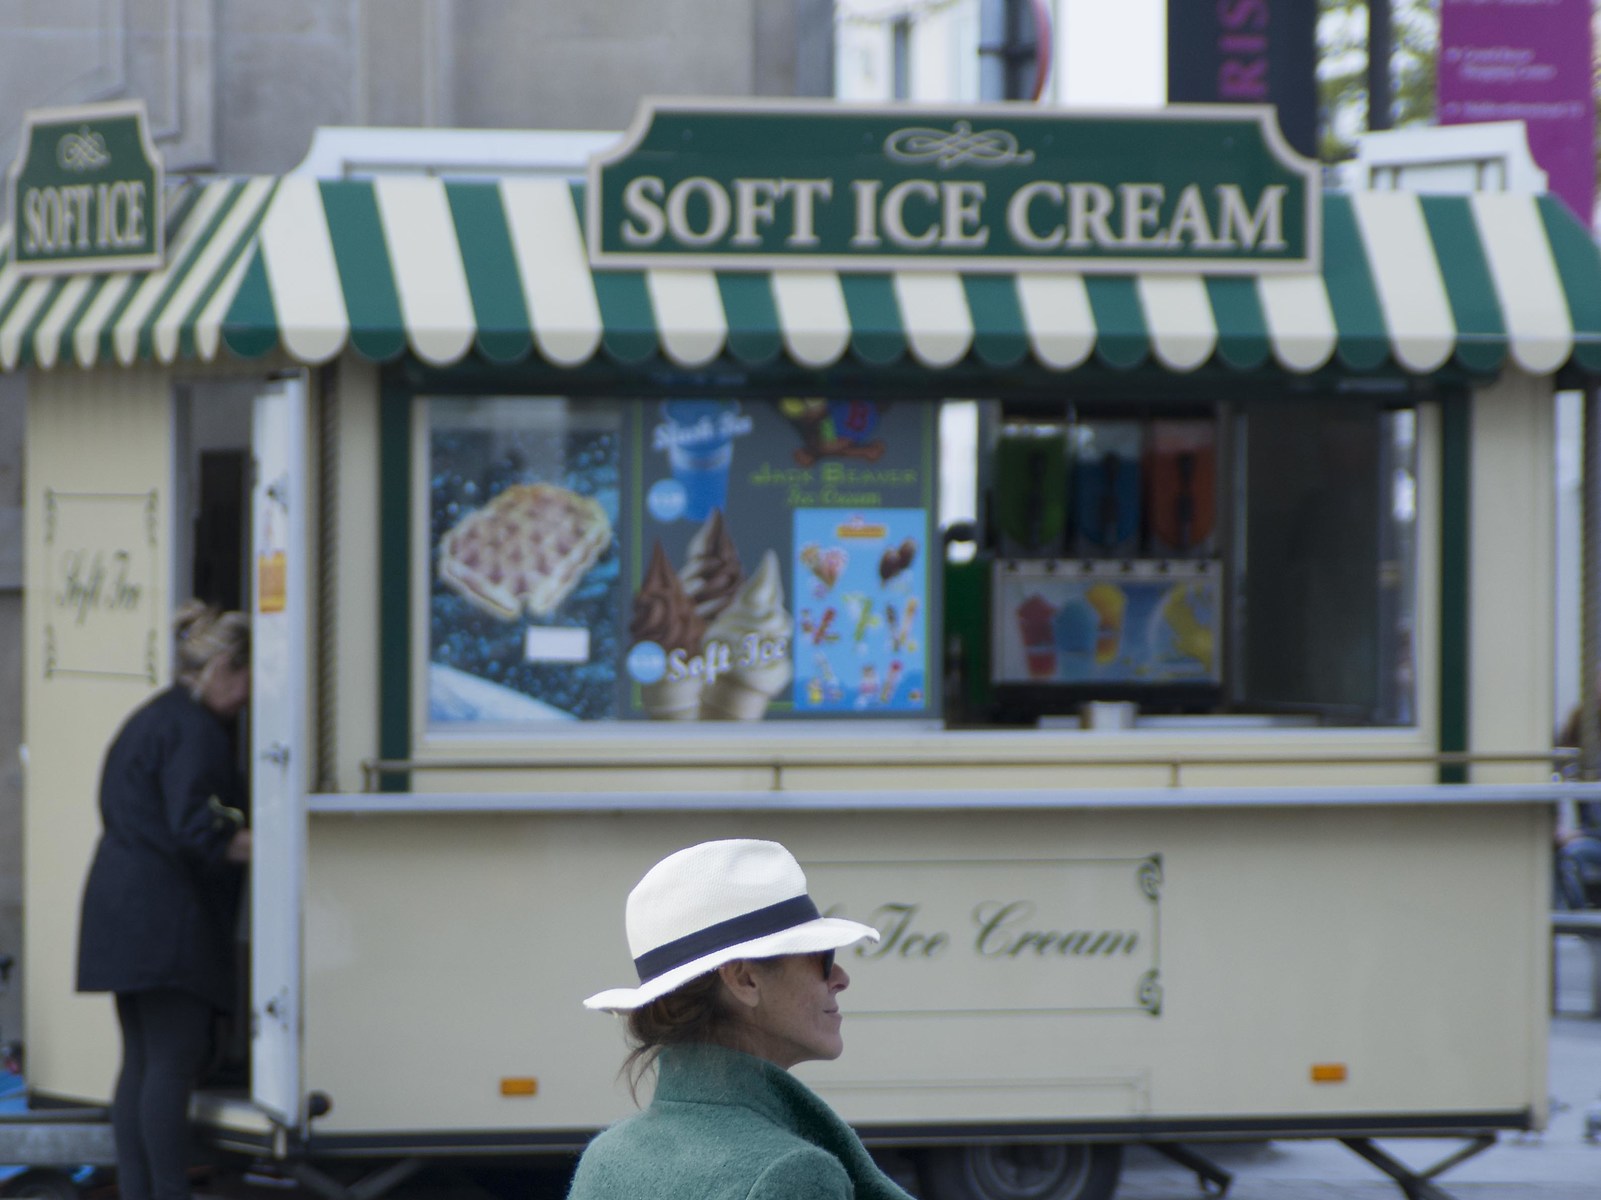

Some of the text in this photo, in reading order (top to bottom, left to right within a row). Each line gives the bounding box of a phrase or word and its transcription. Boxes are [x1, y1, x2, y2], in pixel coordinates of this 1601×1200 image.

[23, 180, 147, 255] SOFT ICE
[620, 174, 1289, 251] SOFT ICE CREAM
[667, 632, 788, 684] Soft Ice
[853, 899, 1139, 960] Ice Cream
